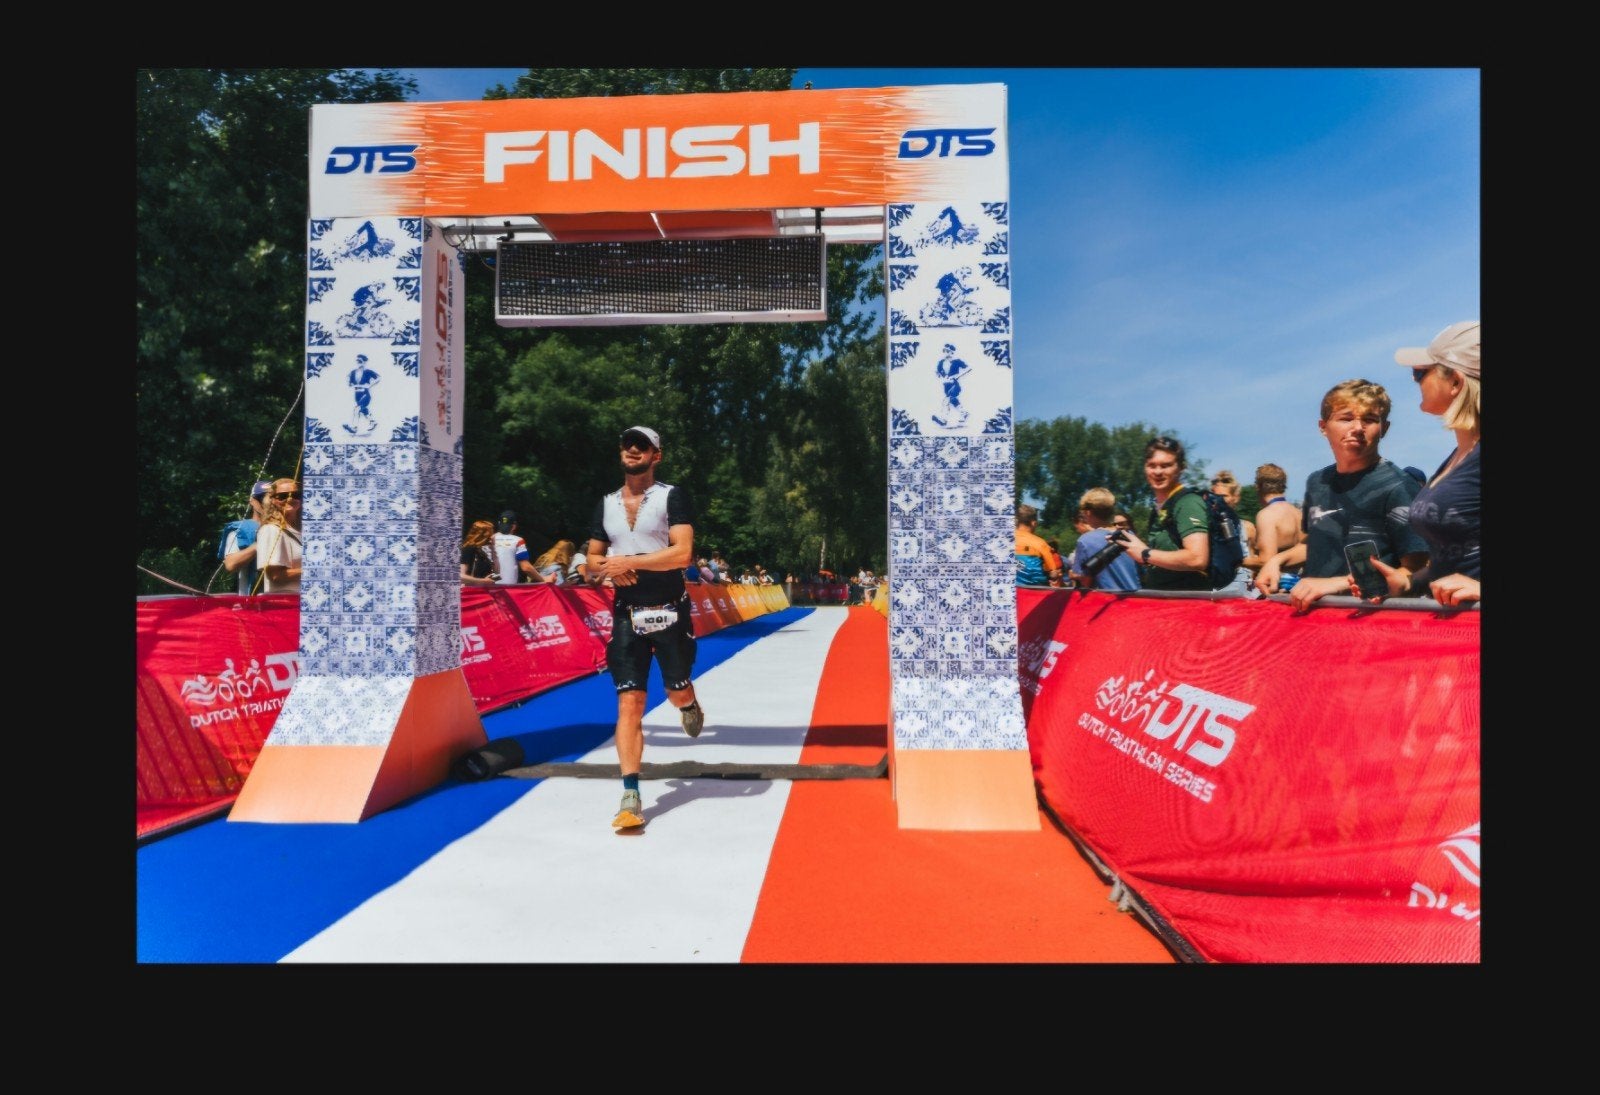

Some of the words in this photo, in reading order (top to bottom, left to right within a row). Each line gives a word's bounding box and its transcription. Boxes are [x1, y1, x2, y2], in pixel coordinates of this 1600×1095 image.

[325, 145, 419, 175] DTS
[484, 122, 820, 184] FINISH
[897, 127, 996, 160] DTS
[189, 707, 240, 728] DUTCH
[1143, 682, 1258, 768] DTS
[1078, 712, 1109, 738] DUTCH
[1106, 727, 1167, 774] TRIATHLON
[1164, 761, 1217, 803] SERIES
